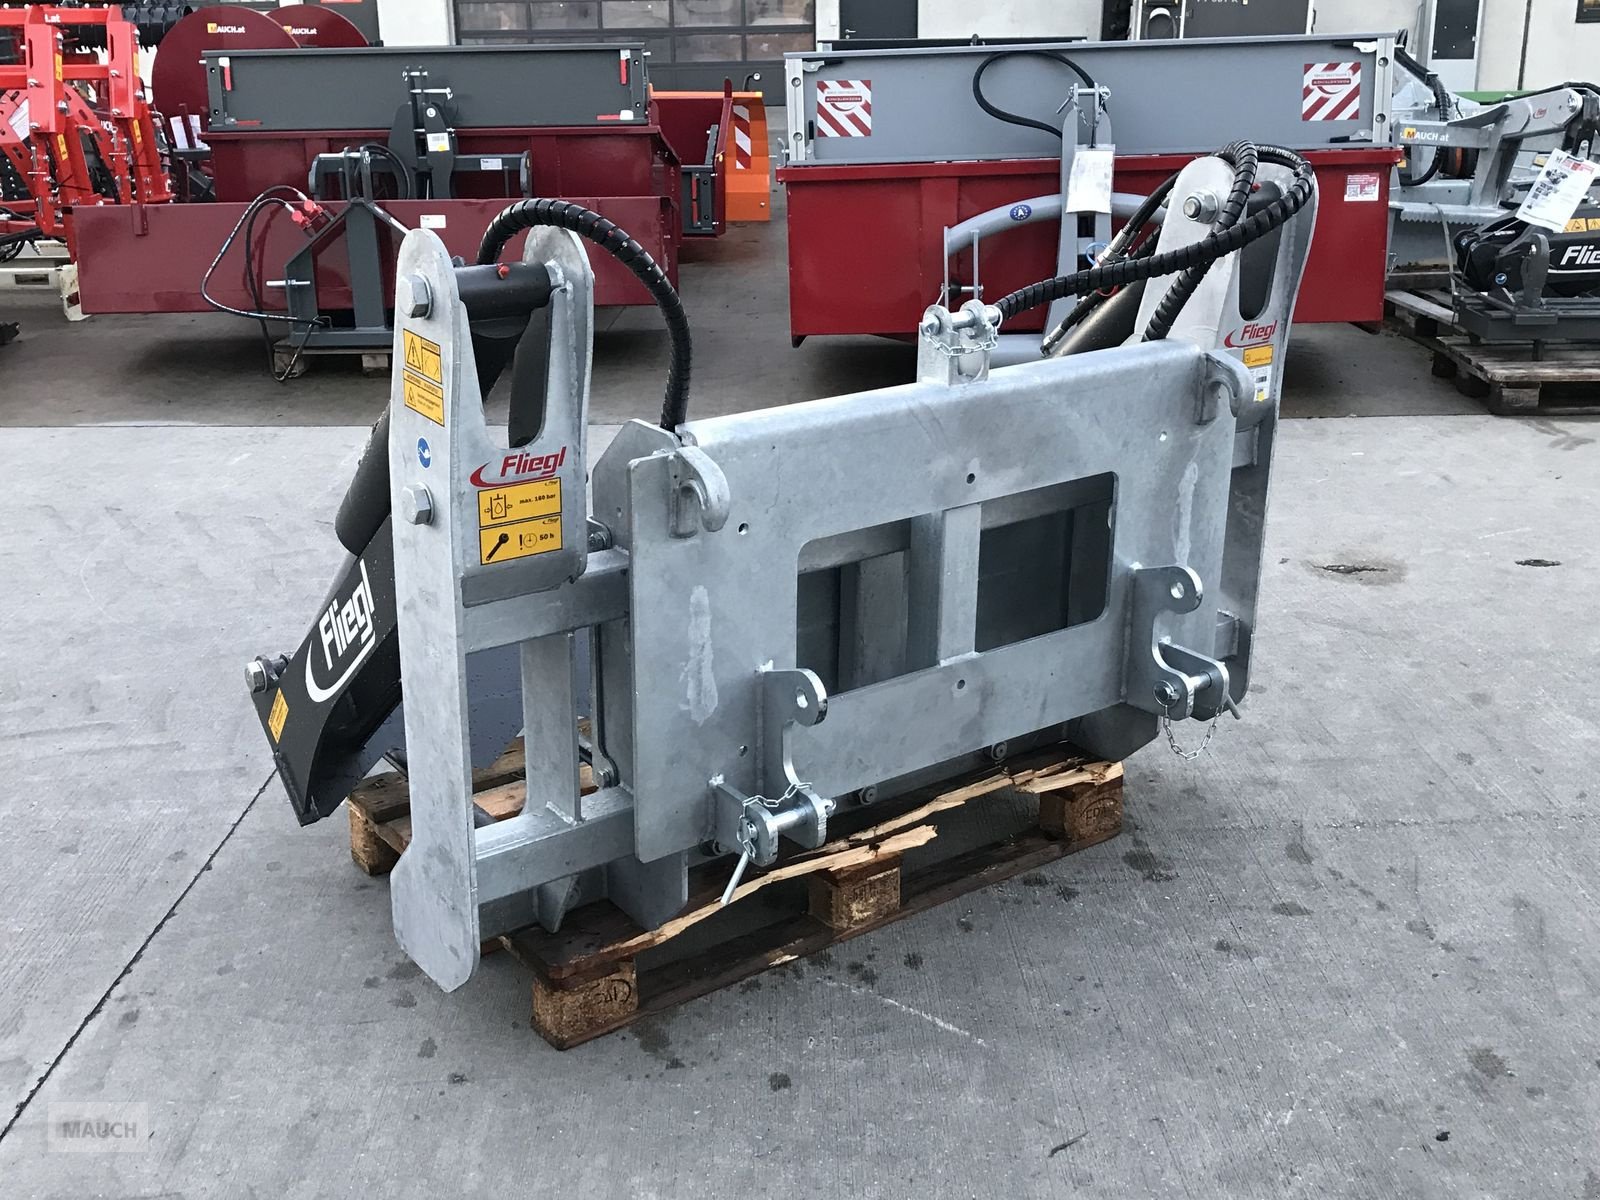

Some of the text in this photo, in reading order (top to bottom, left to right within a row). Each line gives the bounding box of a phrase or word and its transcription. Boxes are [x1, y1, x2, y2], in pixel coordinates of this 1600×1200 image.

[1240, 319, 1278, 341] Fliegl
[500, 446, 567, 478] Fliegl
[318, 558, 375, 672] Fliegl
